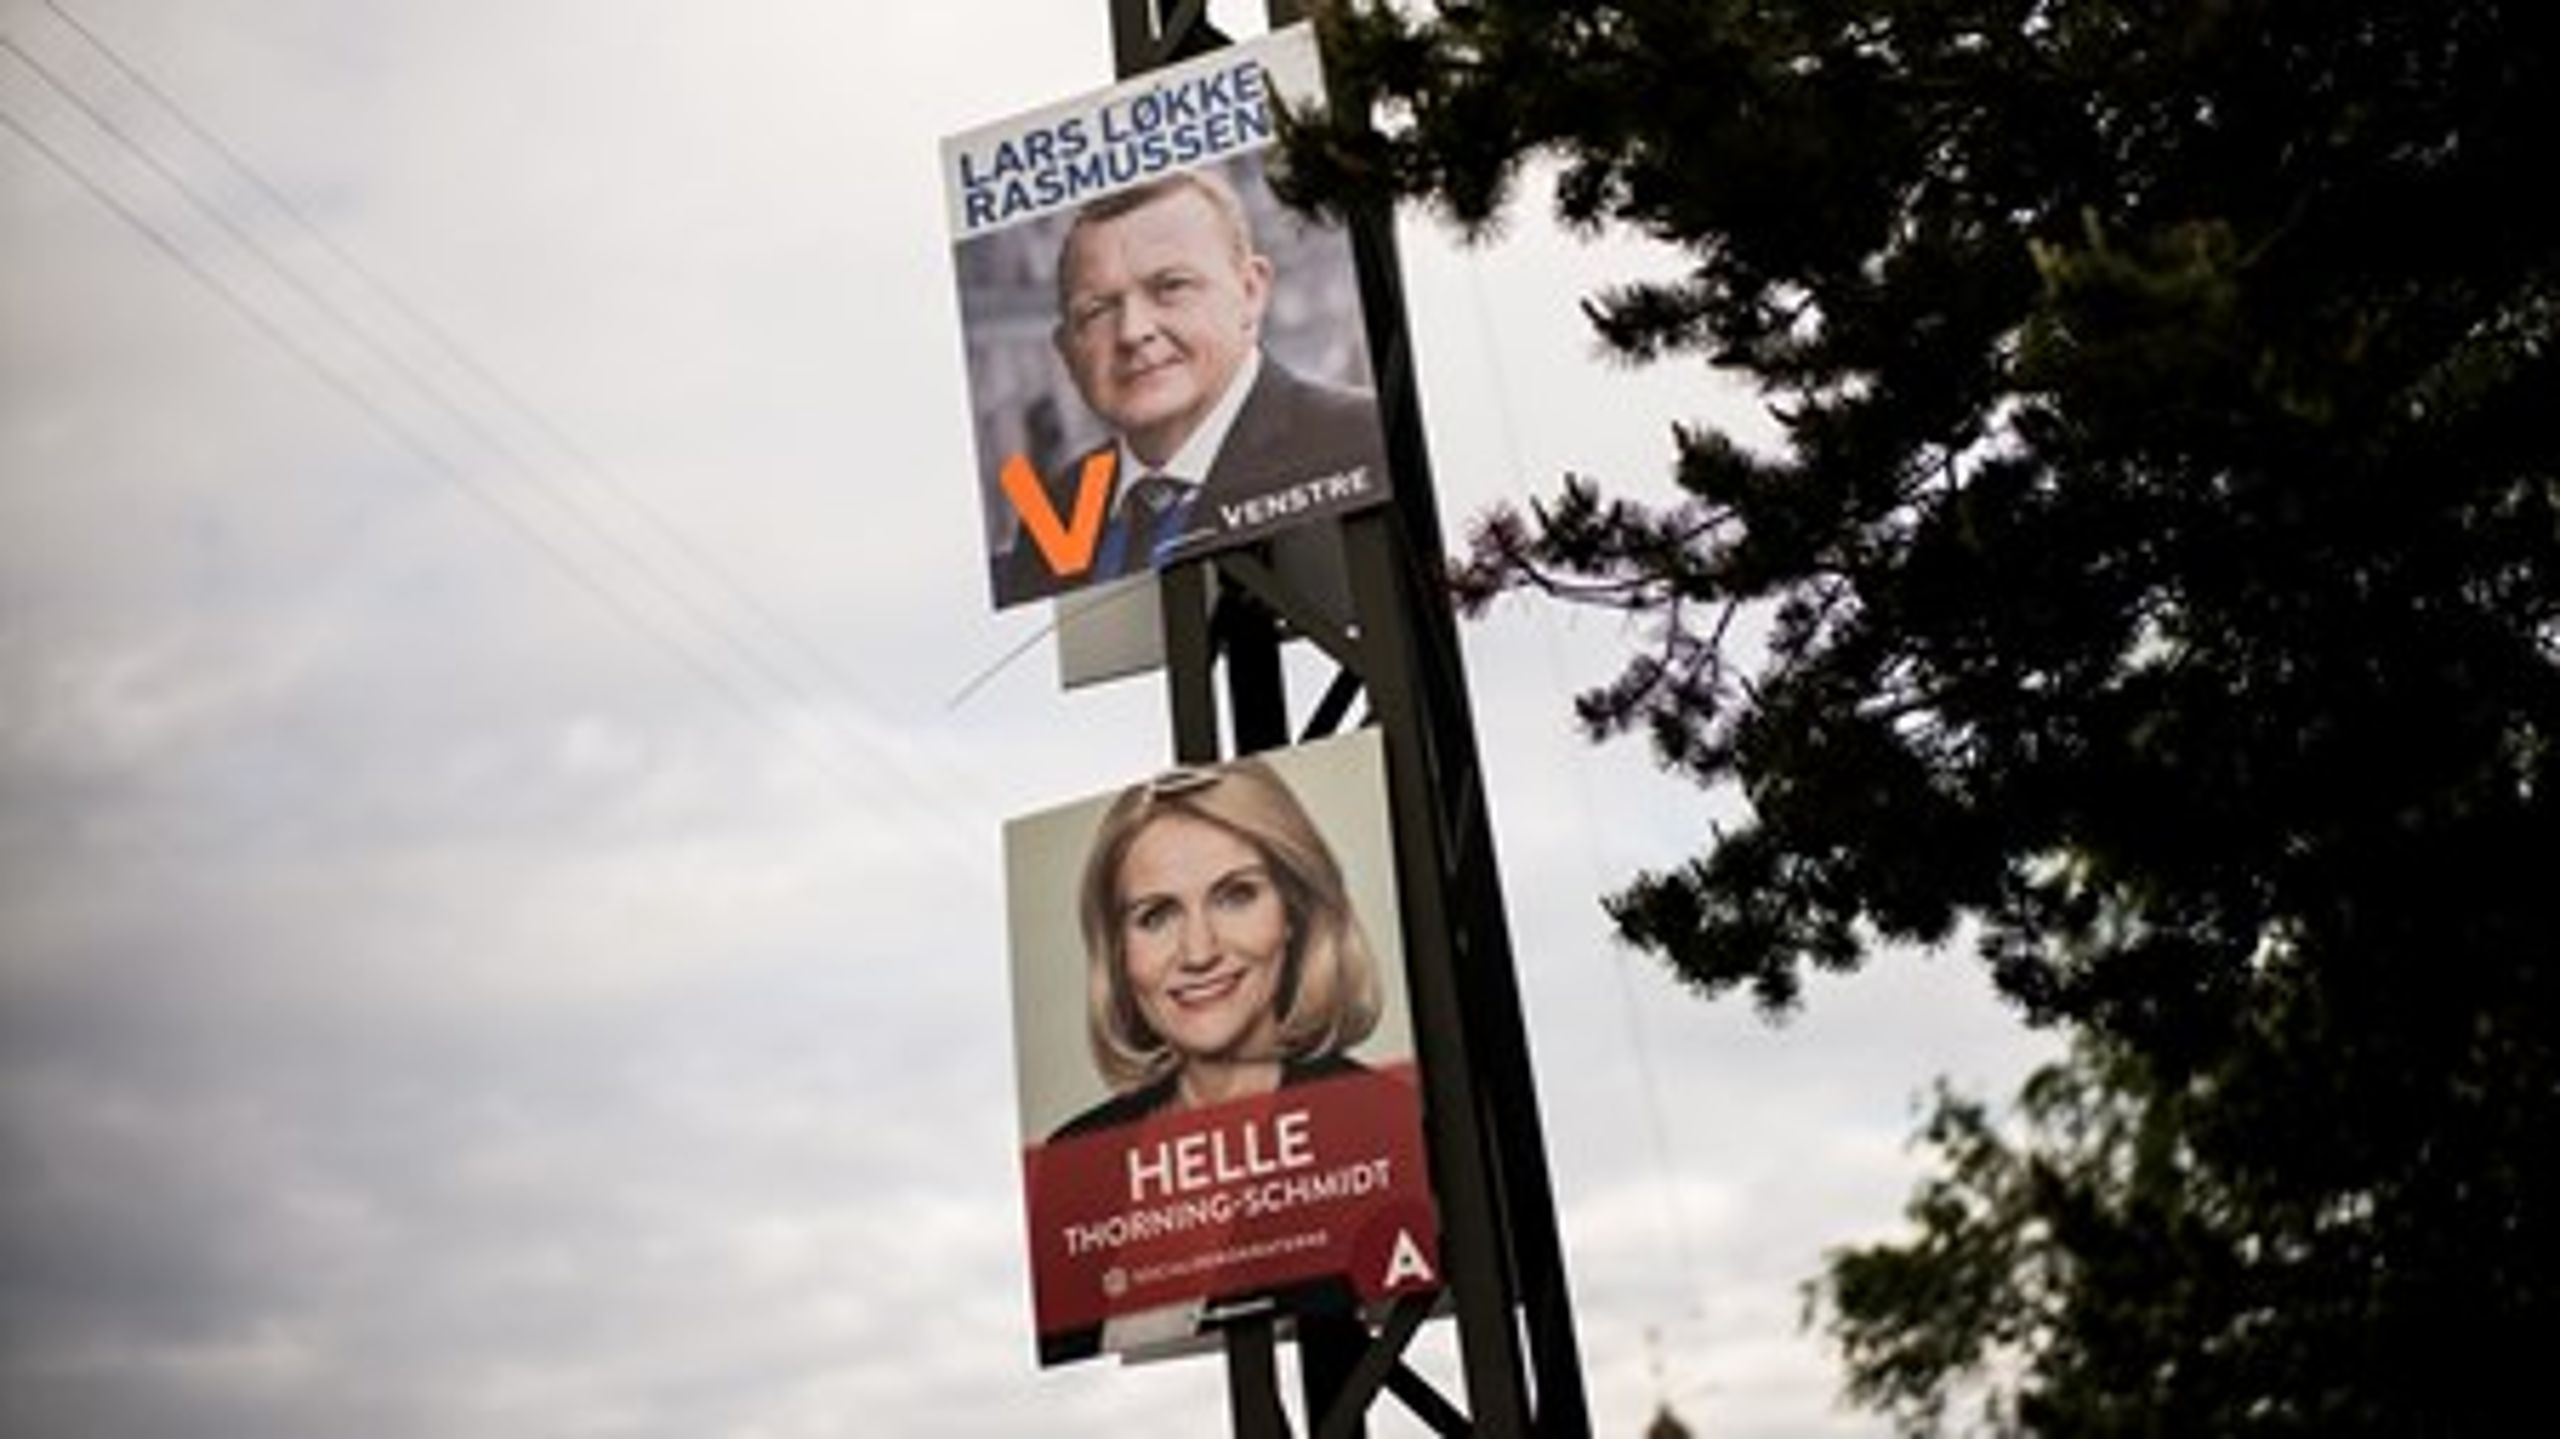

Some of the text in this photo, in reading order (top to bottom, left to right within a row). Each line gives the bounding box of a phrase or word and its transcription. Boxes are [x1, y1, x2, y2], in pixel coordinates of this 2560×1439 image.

[960, 60, 1265, 188] LARS LØKKE
[964, 105, 1271, 229] RASMUSSEN
[1000, 450, 1117, 576] V
[1219, 466, 1373, 529] VENSTRE
[1127, 1109, 1314, 1201] HELLE
[1063, 1158, 1392, 1256] THORNING-SCHMIDT
[1384, 1228, 1434, 1288] A
